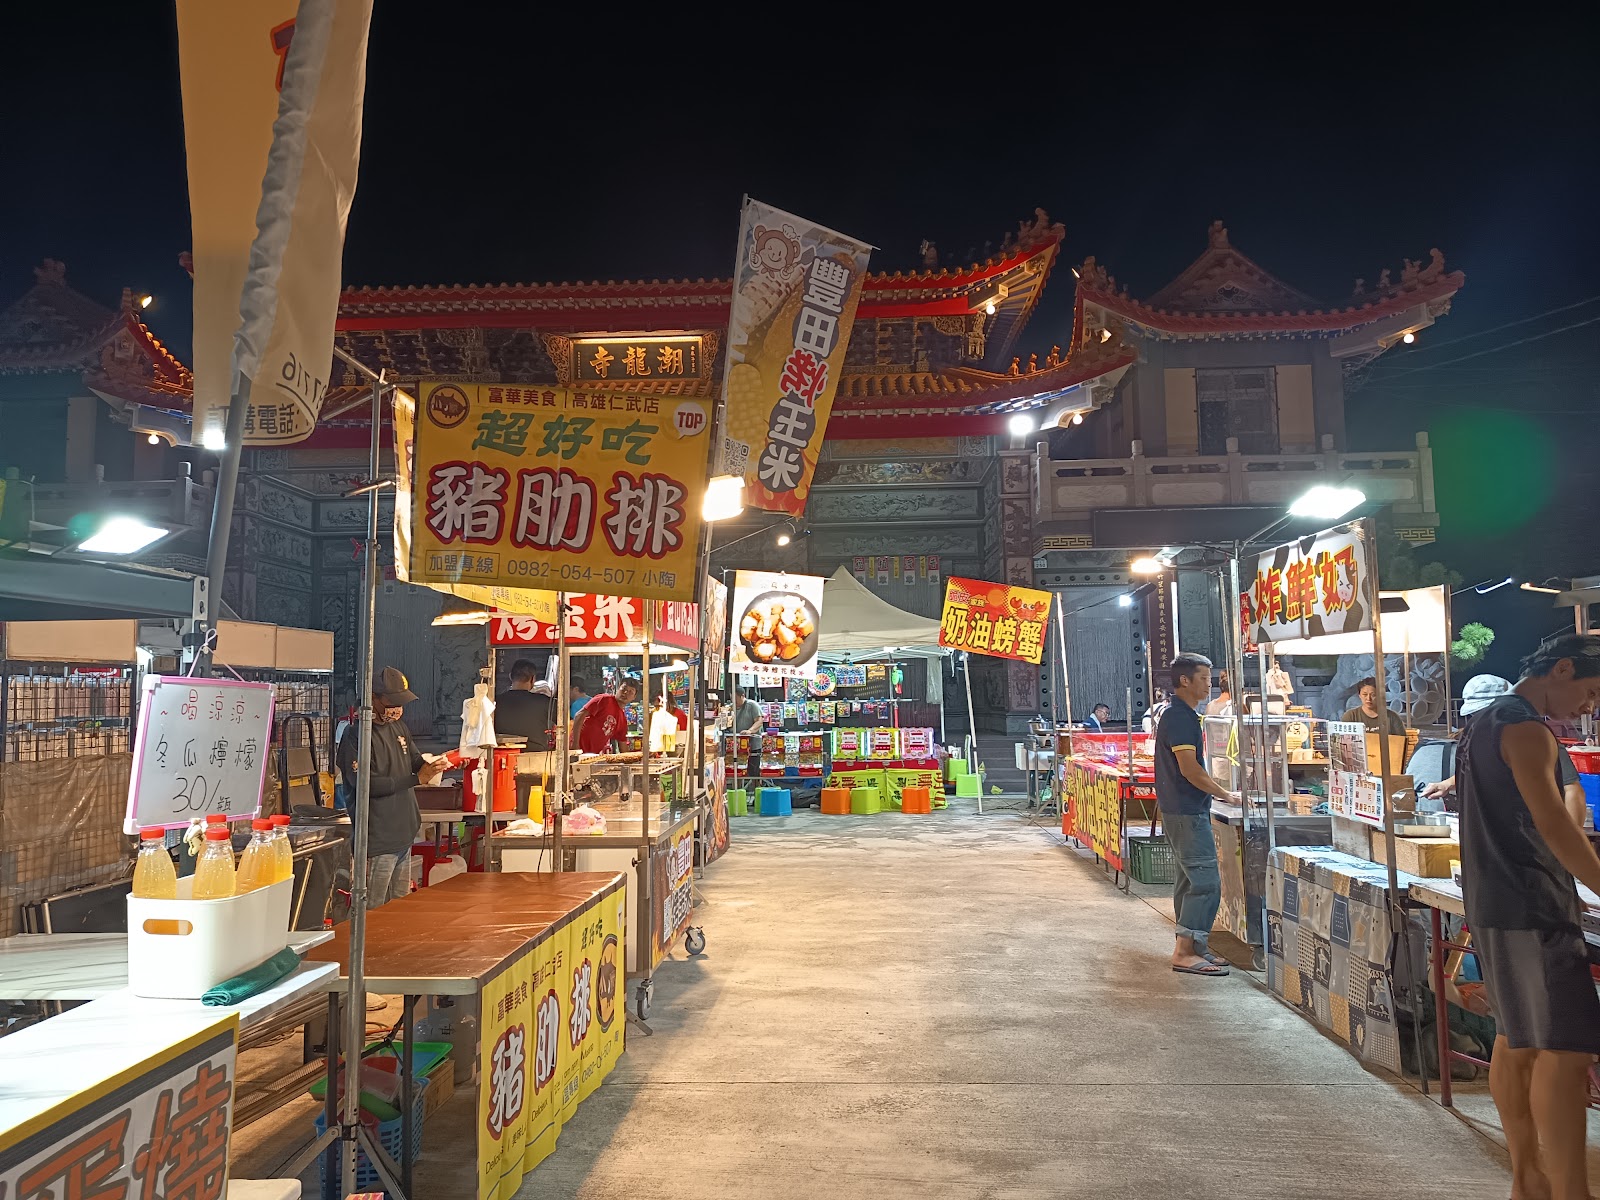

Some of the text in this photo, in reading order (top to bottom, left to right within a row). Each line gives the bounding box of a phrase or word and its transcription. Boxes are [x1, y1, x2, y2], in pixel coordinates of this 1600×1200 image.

[487, 386, 661, 415] 富華美食 高雄仁武店
[677, 411, 703, 430] TOP
[471, 409, 660, 466] 超好吃
[425, 460, 691, 561] 豬肋排
[428, 553, 677, 589] 加盟專線 0982-054-507 小陶
[1254, 544, 1359, 627] 炸鮮奶
[943, 605, 1043, 660] 奶油螃蟹
[155, 733, 258, 771] 冬瓜檸檬
[486, 957, 592, 1141] 豬肋排
